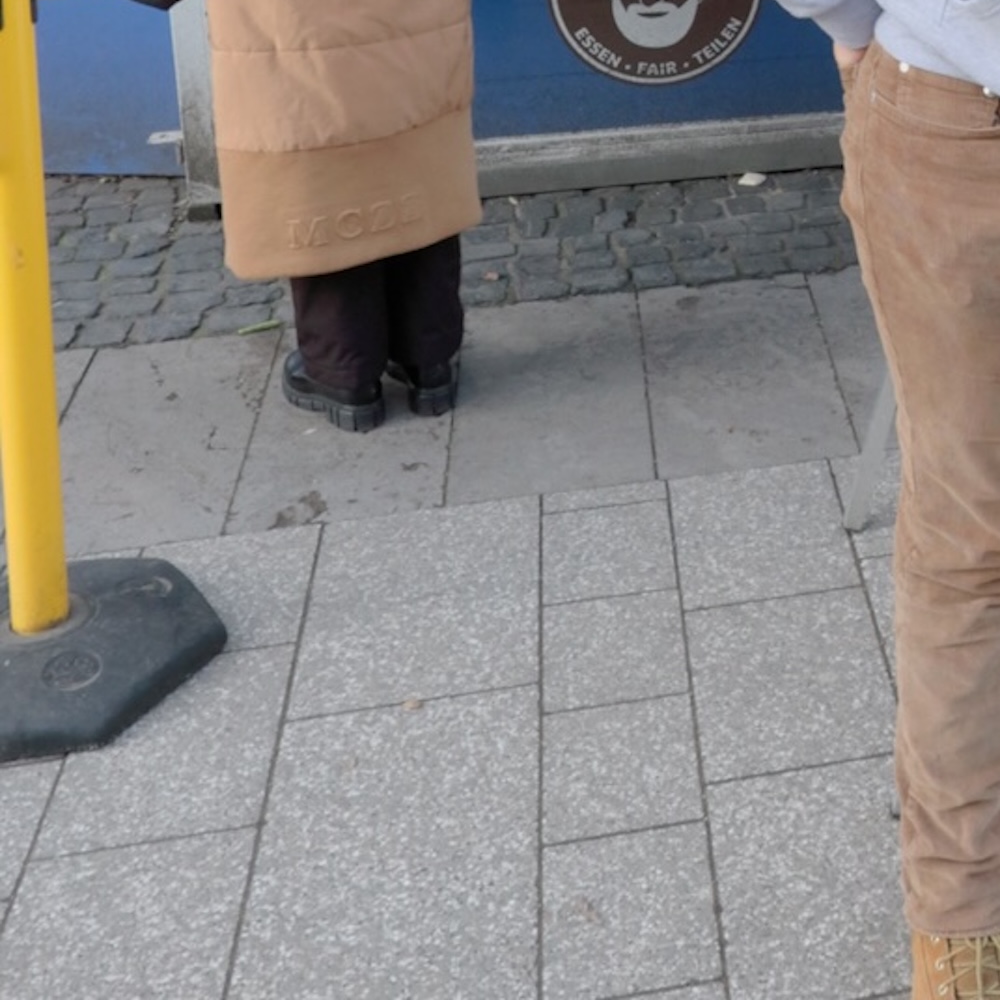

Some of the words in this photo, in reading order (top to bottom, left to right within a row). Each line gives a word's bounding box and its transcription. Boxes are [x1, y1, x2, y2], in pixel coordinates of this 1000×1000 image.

[574, 26, 623, 68] ESSEN
[636, 61, 679, 75] FAIR
[691, 16, 742, 65] TEILEN
